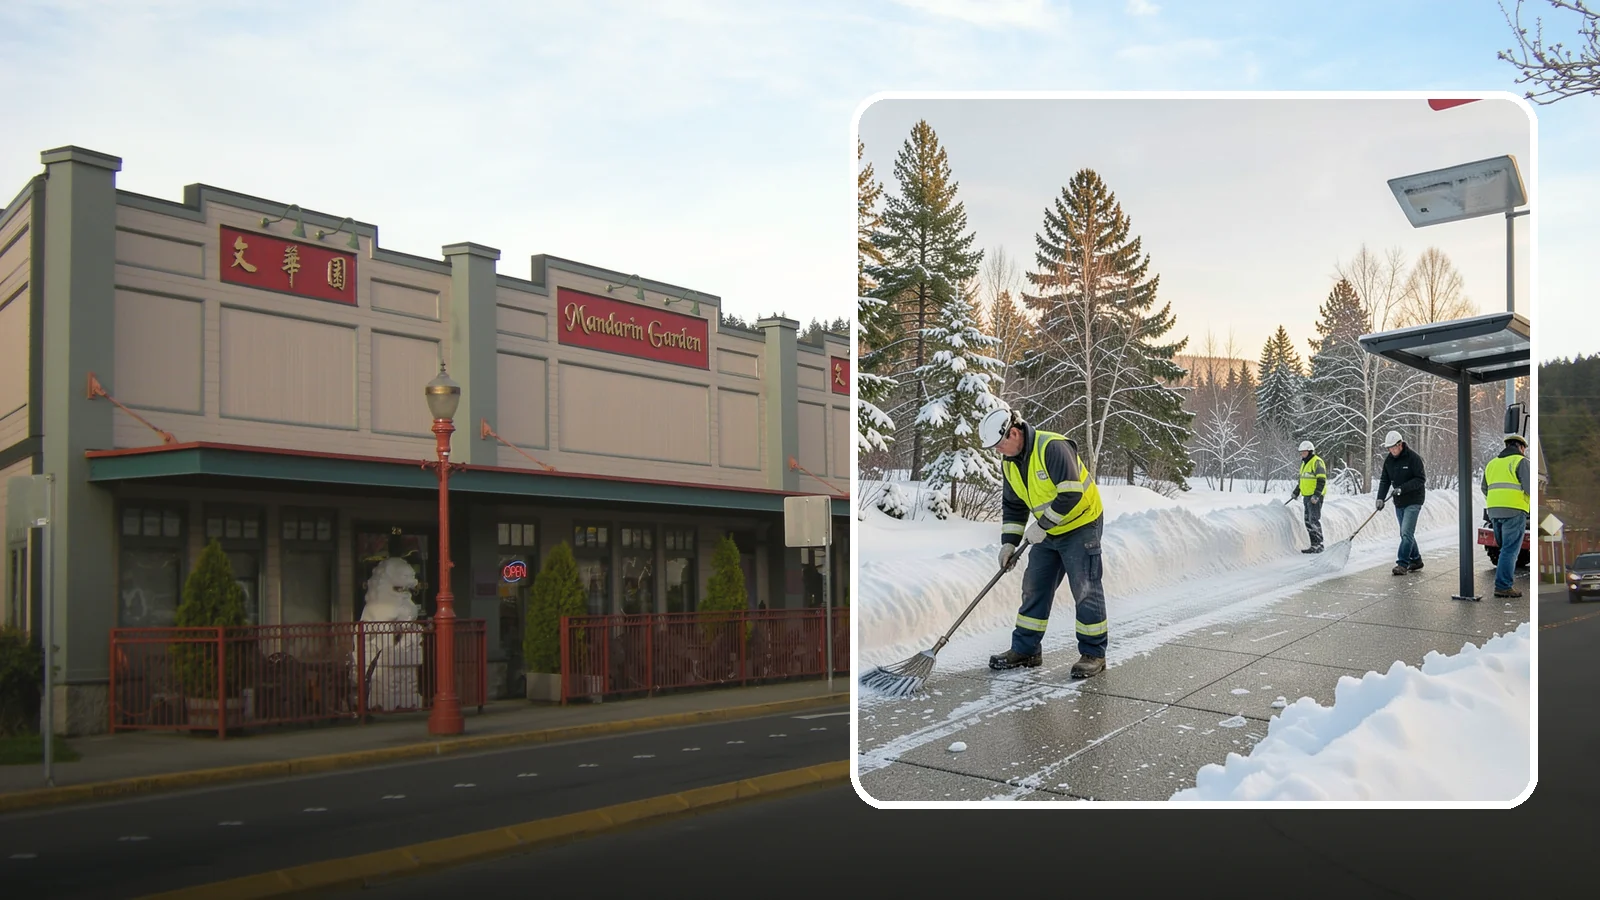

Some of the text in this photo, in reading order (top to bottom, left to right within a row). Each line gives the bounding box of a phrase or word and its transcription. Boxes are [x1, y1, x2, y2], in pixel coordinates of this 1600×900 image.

[231, 236, 346, 291] 文華園
[564, 302, 701, 352] Mandarin Garden
[503, 565, 527, 578] OPEN
